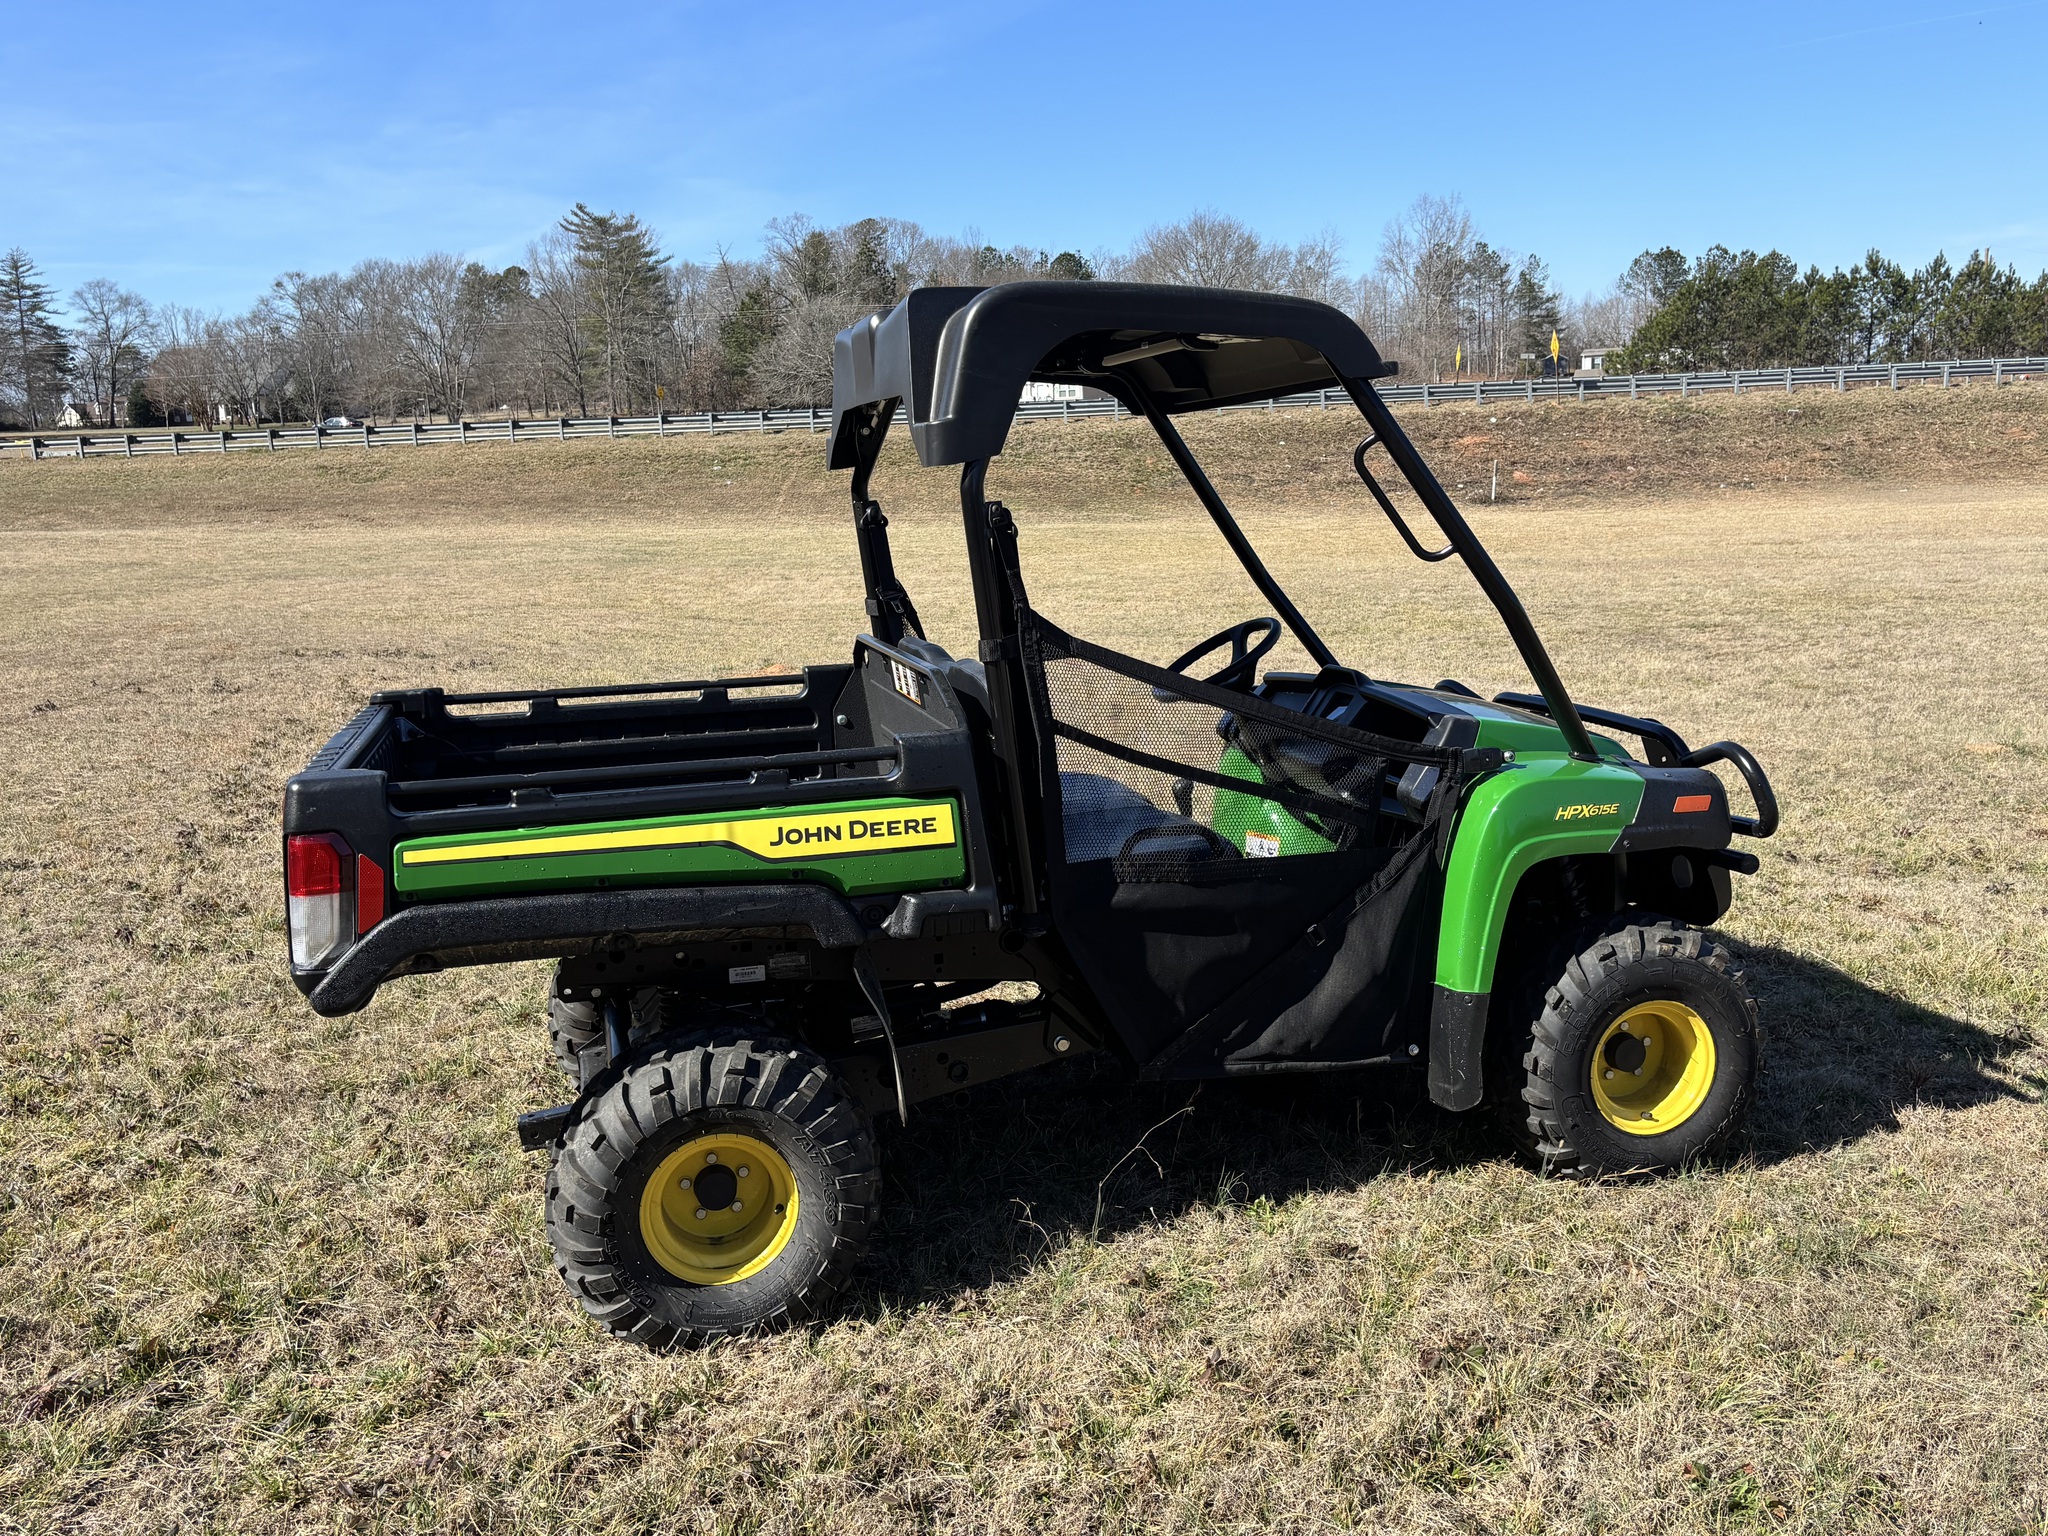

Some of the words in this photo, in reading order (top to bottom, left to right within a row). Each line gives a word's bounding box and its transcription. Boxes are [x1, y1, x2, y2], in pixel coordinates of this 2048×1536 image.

[1554, 803, 1620, 821] HPX615E
[769, 825, 842, 847] JOHN
[849, 817, 937, 840] DEERE
